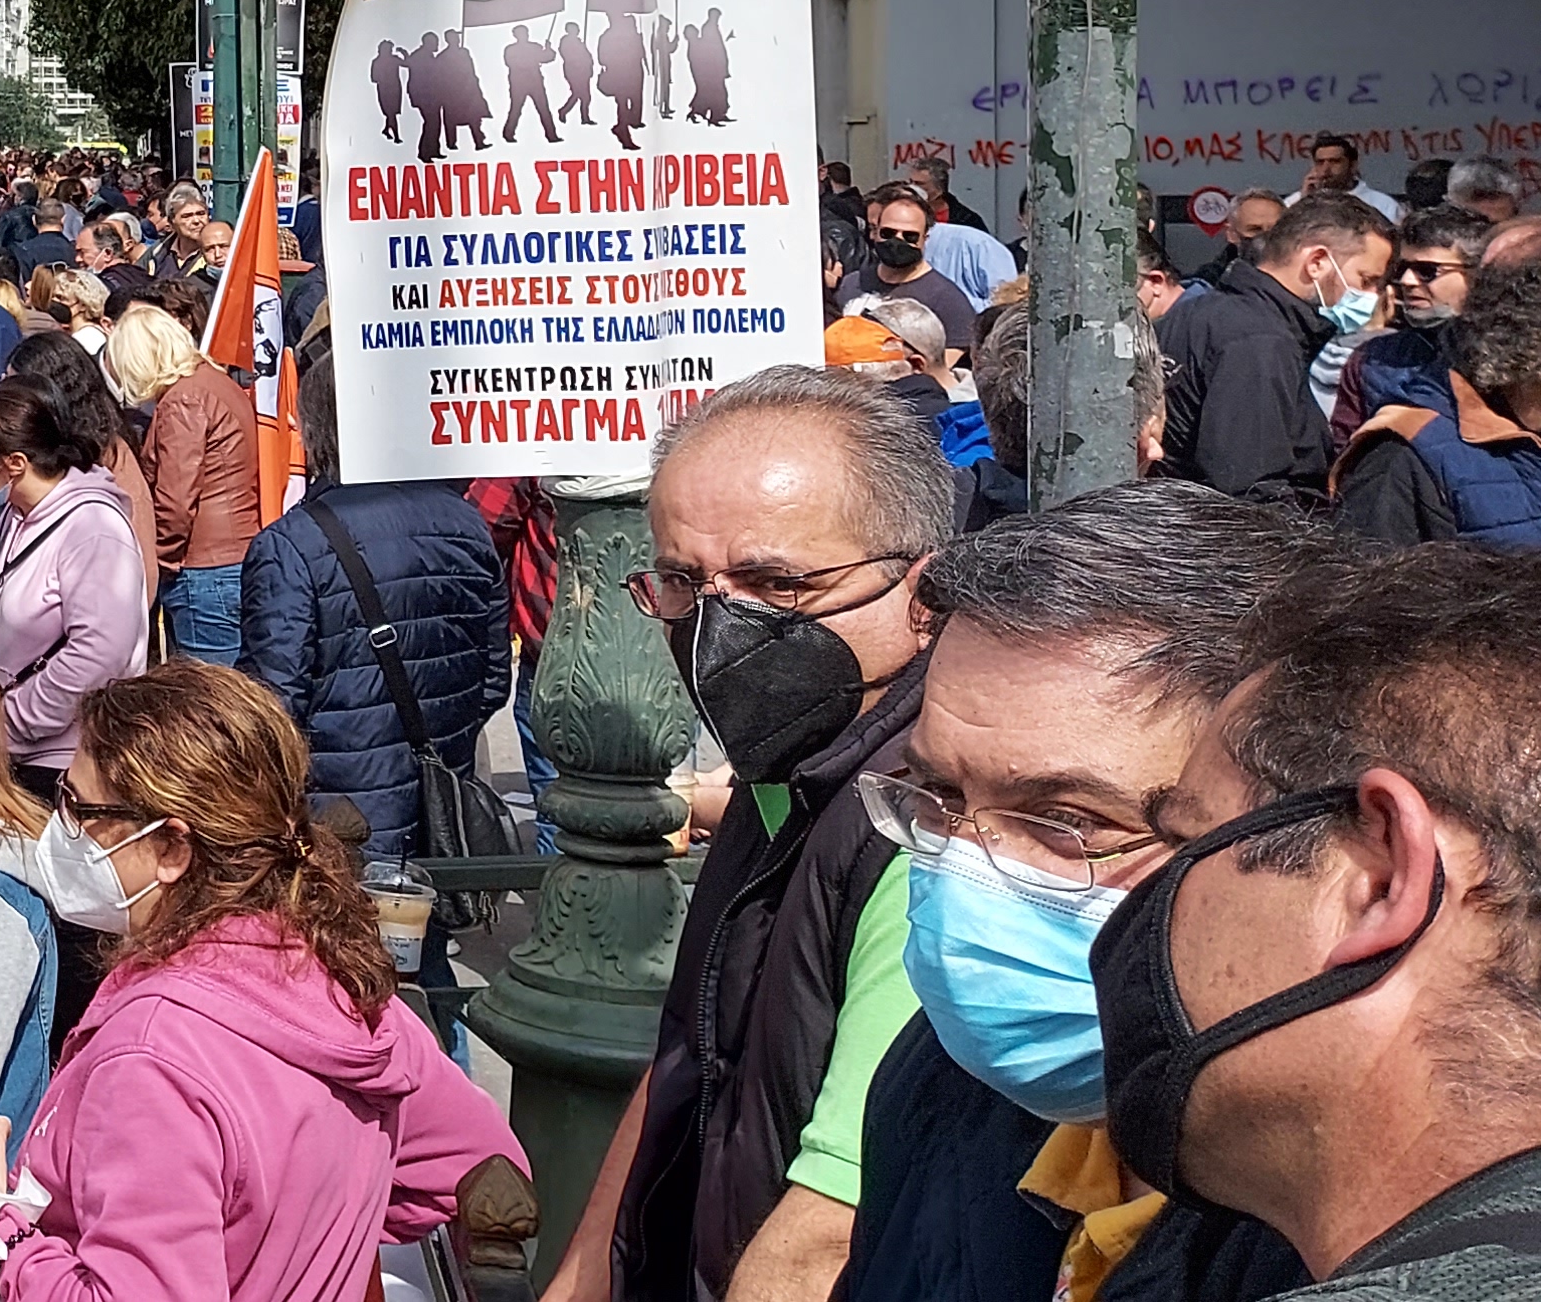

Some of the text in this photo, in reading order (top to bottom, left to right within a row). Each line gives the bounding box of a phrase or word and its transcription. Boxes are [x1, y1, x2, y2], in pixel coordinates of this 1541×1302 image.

[1184, 72, 1381, 106] ΜΠΟΡΕΙΣ
[348, 161, 522, 221] ΕΝΑΝΤΙΑ
[535, 158, 646, 216] ΣΤΗΝ
[388, 234, 433, 269] ΓΙΑ
[443, 228, 634, 267] ΣΥΛΛΟΓΙΚΕΣ
[392, 283, 429, 310] ΚΑΙ
[438, 275, 573, 309] ΑΥΞΗΣΕΙΣ
[361, 320, 425, 350] ΚΑΜΙΑ
[430, 316, 534, 349] ΕΜΠΛΟΚΗ
[542, 314, 585, 344] ΤΗΣ
[692, 306, 785, 335] ΠΟΛΕΜΟ
[429, 363, 612, 395] ΣΥΓΚΕΝΤΡΩΣΗ
[429, 397, 647, 446] ΣΥΝΤΑΓΜΑ
